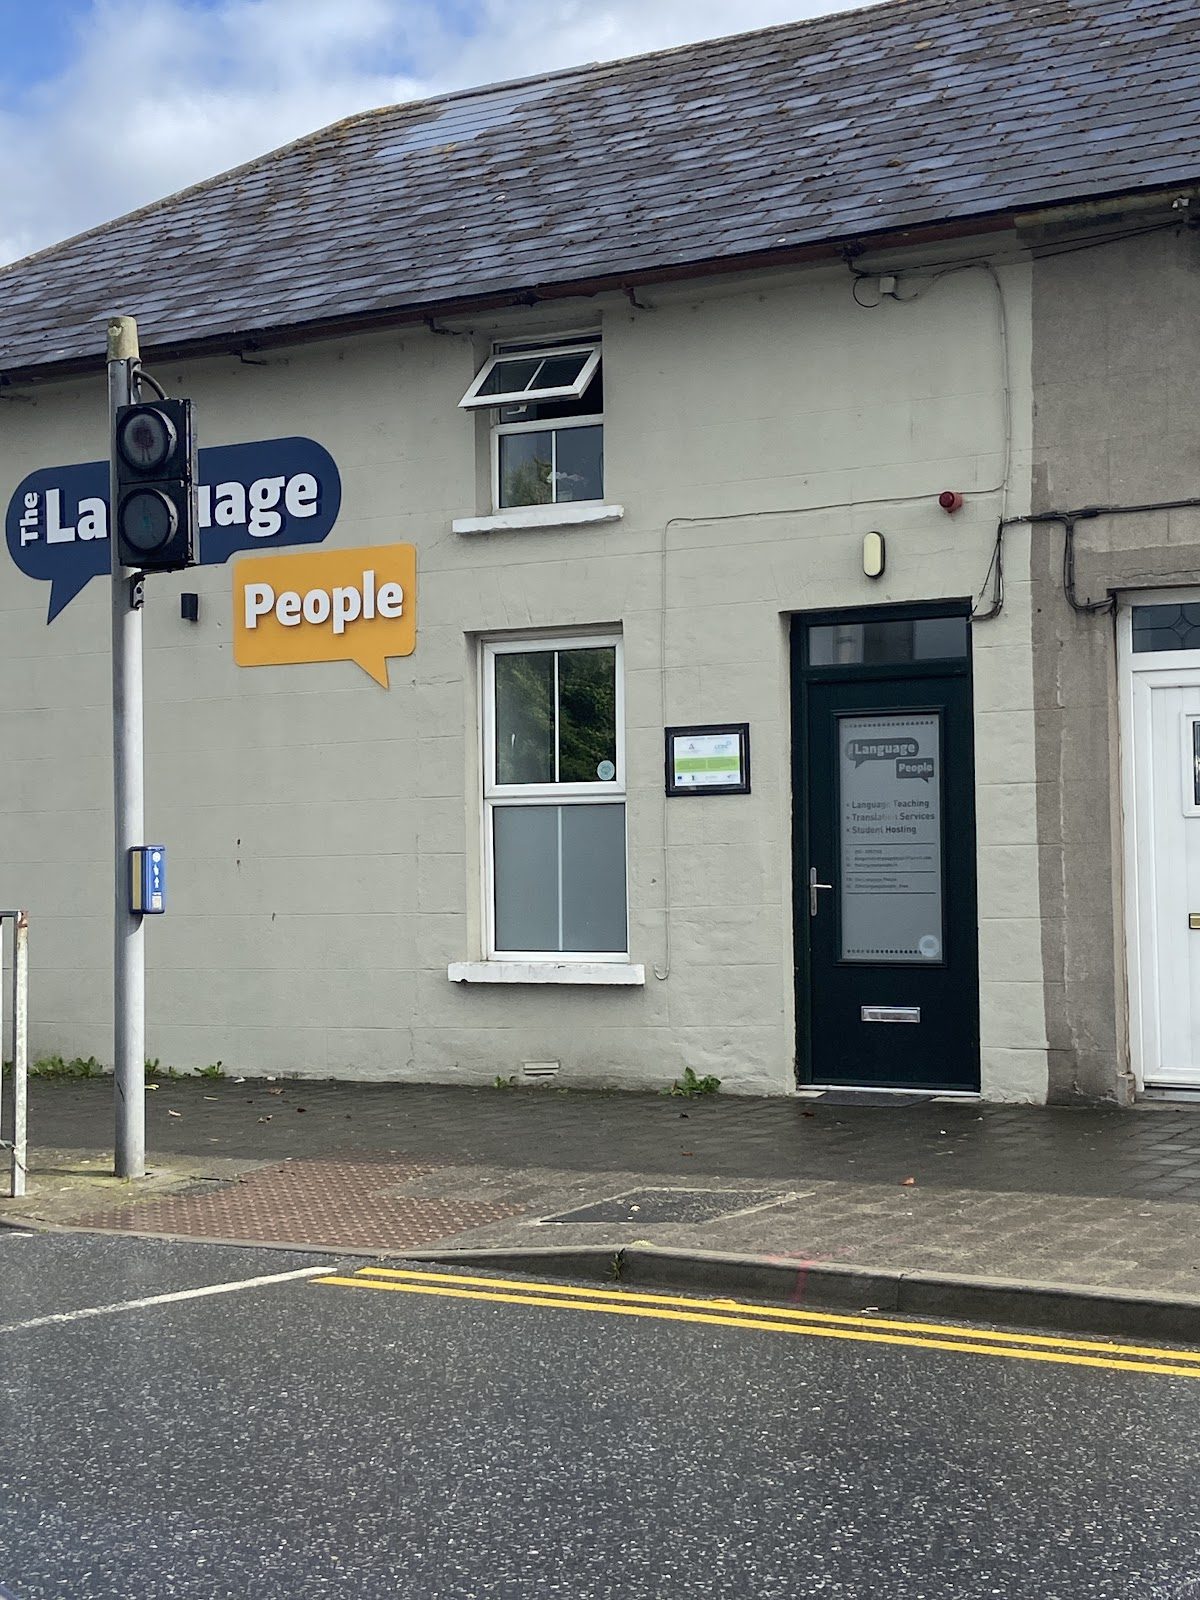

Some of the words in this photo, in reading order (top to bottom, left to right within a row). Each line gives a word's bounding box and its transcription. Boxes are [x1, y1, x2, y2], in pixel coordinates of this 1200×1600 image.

[45, 472, 318, 545] Laage
[19, 491, 40, 547] The
[244, 569, 404, 634] People
[854, 743, 916, 757] Language
[898, 762, 933, 774] People
[852, 801, 890, 810] Languag
[893, 799, 930, 809] Teaching
[852, 812, 898, 822] Transla
[899, 811, 936, 821] Services
[852, 825, 883, 834] Student
[885, 825, 917, 835] Hosting
